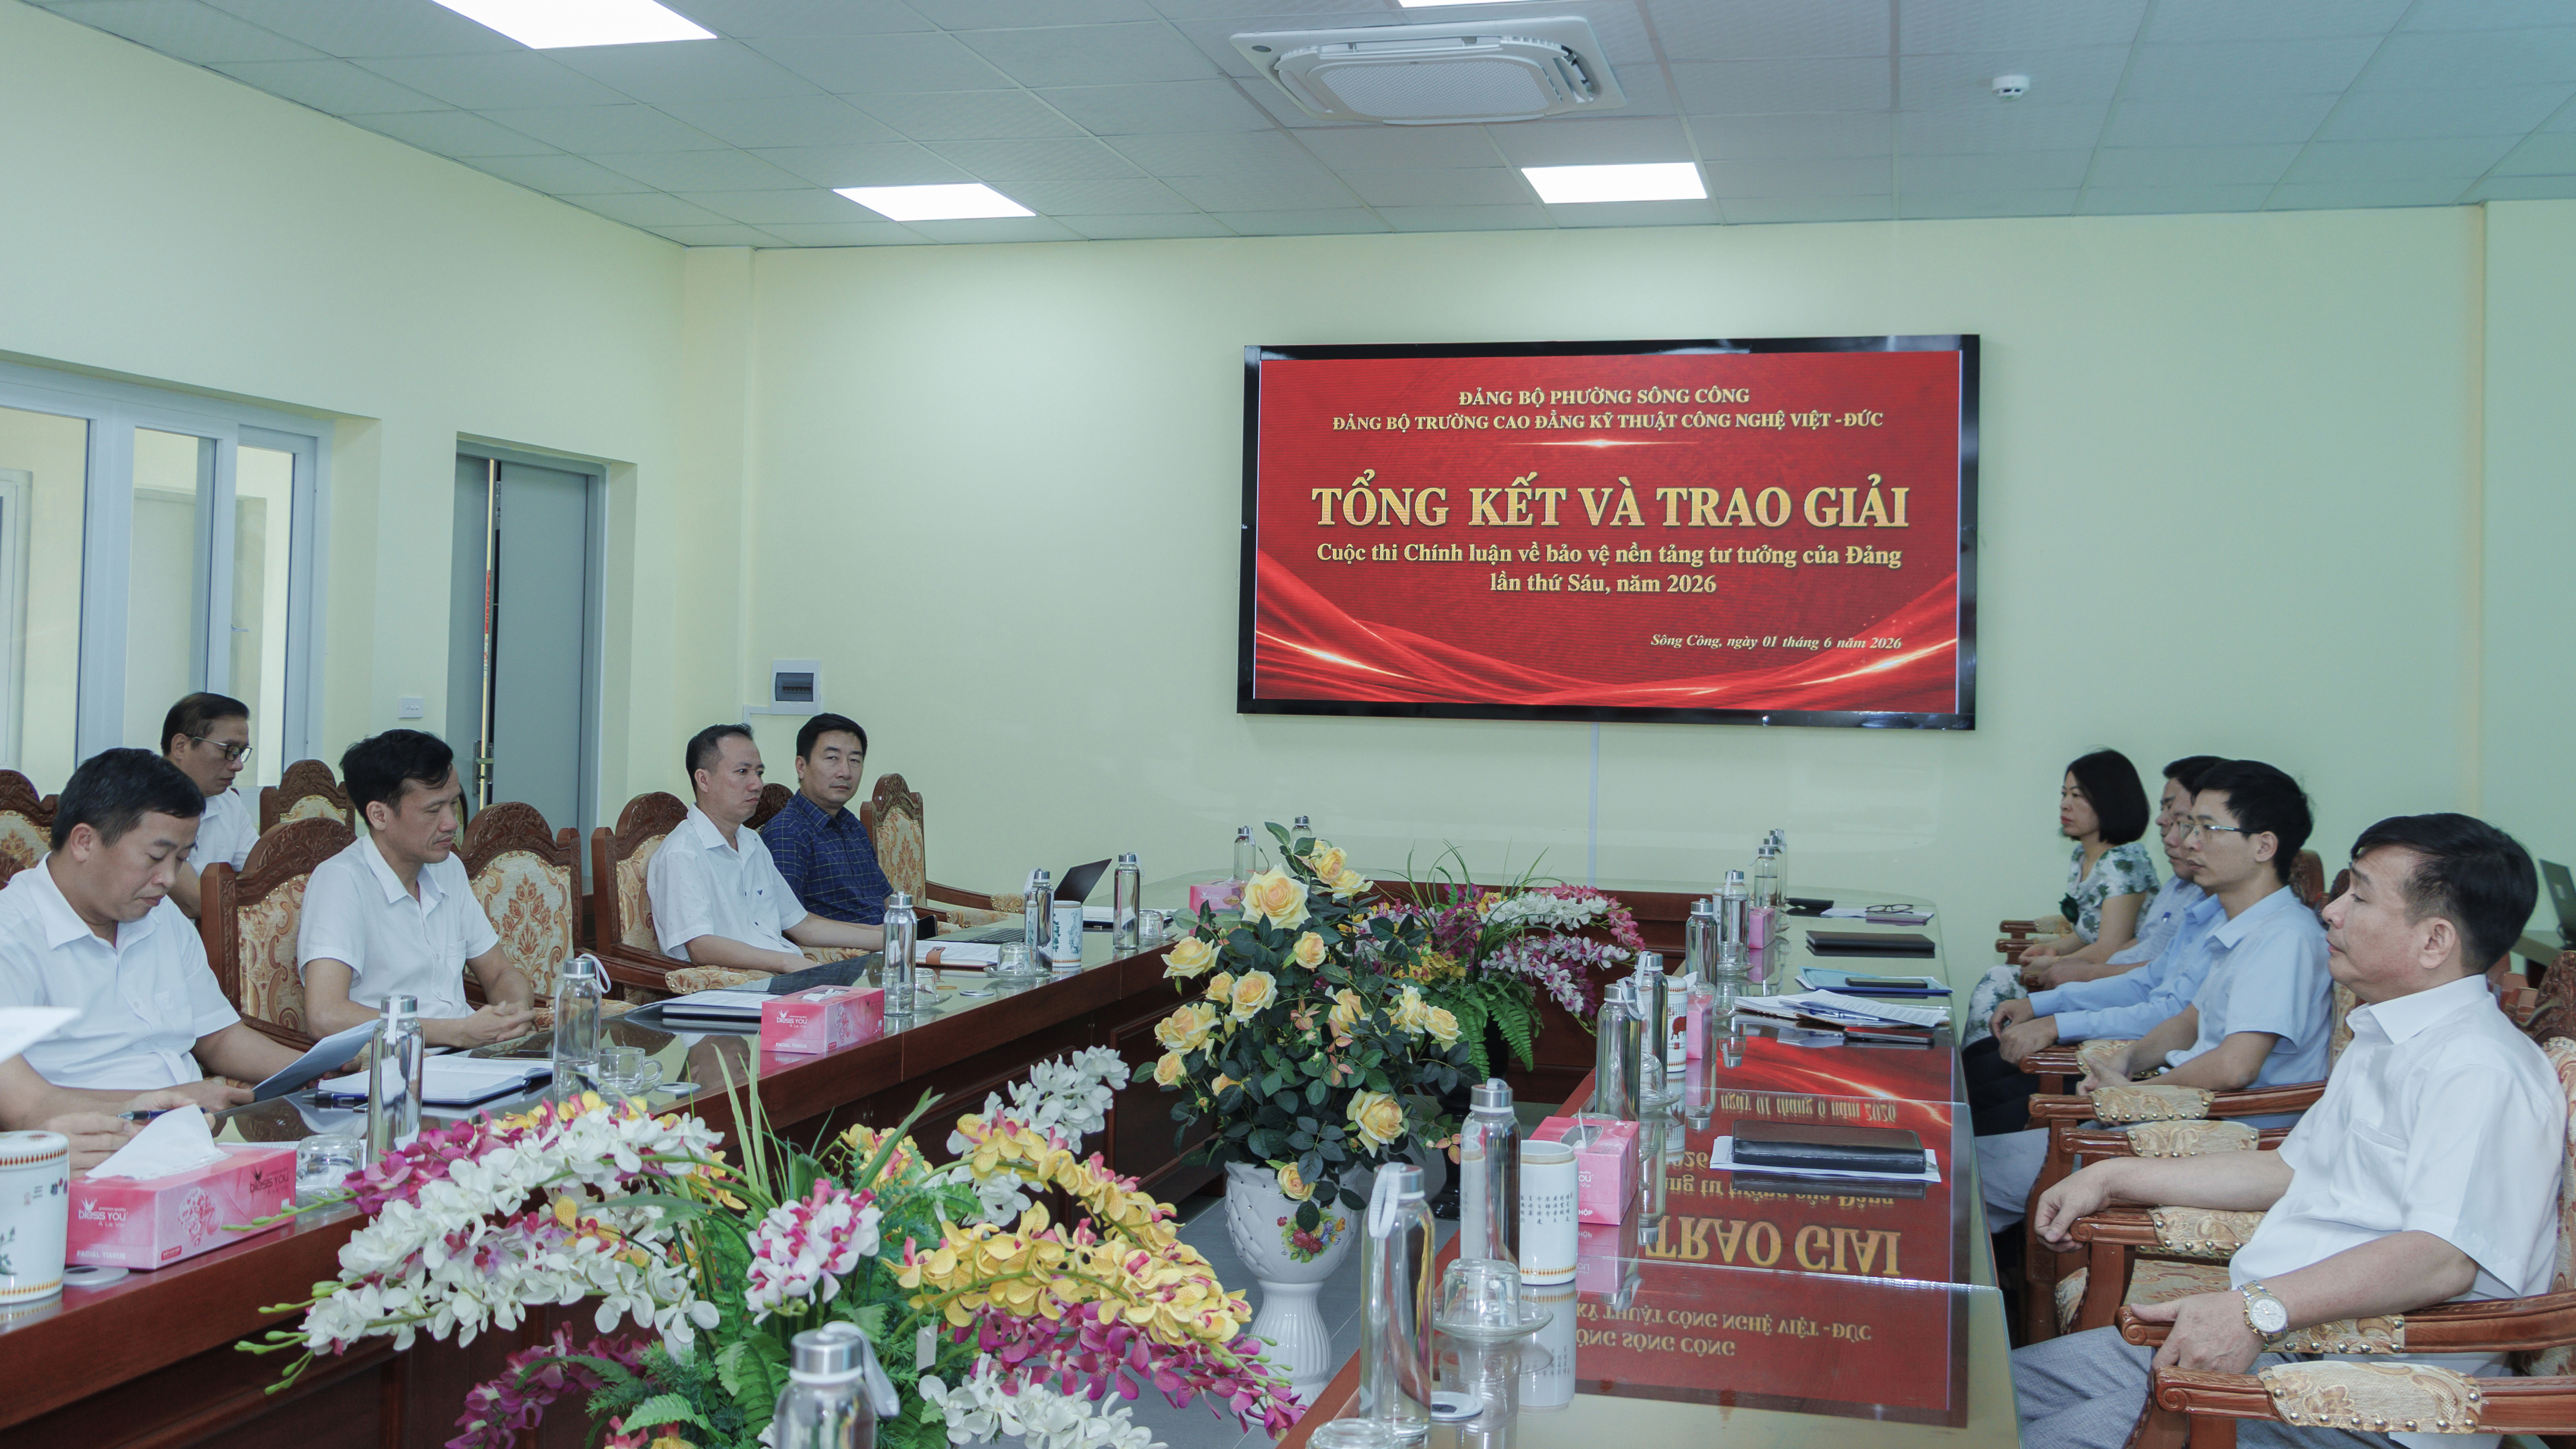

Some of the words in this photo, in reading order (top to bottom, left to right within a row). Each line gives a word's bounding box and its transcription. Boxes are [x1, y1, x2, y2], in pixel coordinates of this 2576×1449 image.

[1459, 387, 1513, 405] ĐẢNG
[1518, 387, 1546, 408] BỘ
[1550, 386, 1632, 405] PHƯỜNG
[1637, 385, 1690, 404] SÔNG
[1695, 385, 1750, 404] CÔNG
[1333, 413, 1382, 430] ĐẢNG
[1386, 413, 1410, 433] BỘ
[1415, 413, 1489, 429] TRƯỜNG
[1493, 416, 1531, 429] CAO
[1534, 409, 1585, 428] ĐẲNG
[1589, 411, 1613, 428] KỸ
[1617, 411, 1678, 431] THUẬT
[1681, 410, 1732, 428] CÔNG
[1735, 410, 1786, 431] NGHỆ
[1789, 410, 1832, 430] VIỆT
[1835, 409, 1883, 427] -ĐỨC
[1312, 469, 1449, 526] TỔNG
[1468, 471, 1567, 526] KẾT
[1577, 476, 1645, 526] VÀ
[1656, 487, 1792, 527] TRAO
[1804, 473, 1910, 527] GIẢI
[1317, 543, 1366, 564] Cuộc
[1371, 543, 1397, 561] thi
[1404, 544, 1463, 561] Chính
[1469, 544, 1512, 565] luận
[1518, 541, 1540, 562] về
[1546, 544, 1582, 562] bảo
[1587, 544, 1610, 566] vệ
[1615, 541, 1652, 562] nền
[1659, 544, 1704, 568] tảng
[1709, 546, 1733, 563] tư
[1737, 544, 1797, 568] tưởng
[1802, 544, 1840, 564] của
[1845, 545, 1902, 569] Đảng
[1490, 570, 1521, 591] lần
[1527, 573, 1563, 591] thứ
[1568, 574, 1611, 594] Sáu,
[1616, 574, 1661, 592] năm
[1667, 574, 1717, 593] 2026
[1651, 634, 1683, 649] Sông
[1686, 635, 1722, 650] Công,
[1727, 636, 1758, 650] ngày
[1762, 636, 1777, 647] 01
[1782, 636, 1820, 650] tháng
[1823, 637, 1832, 648] 6
[1837, 637, 1867, 649] năm
[1869, 637, 1902, 649] 2026
[102, 1251, 126, 1259] TISSUE
